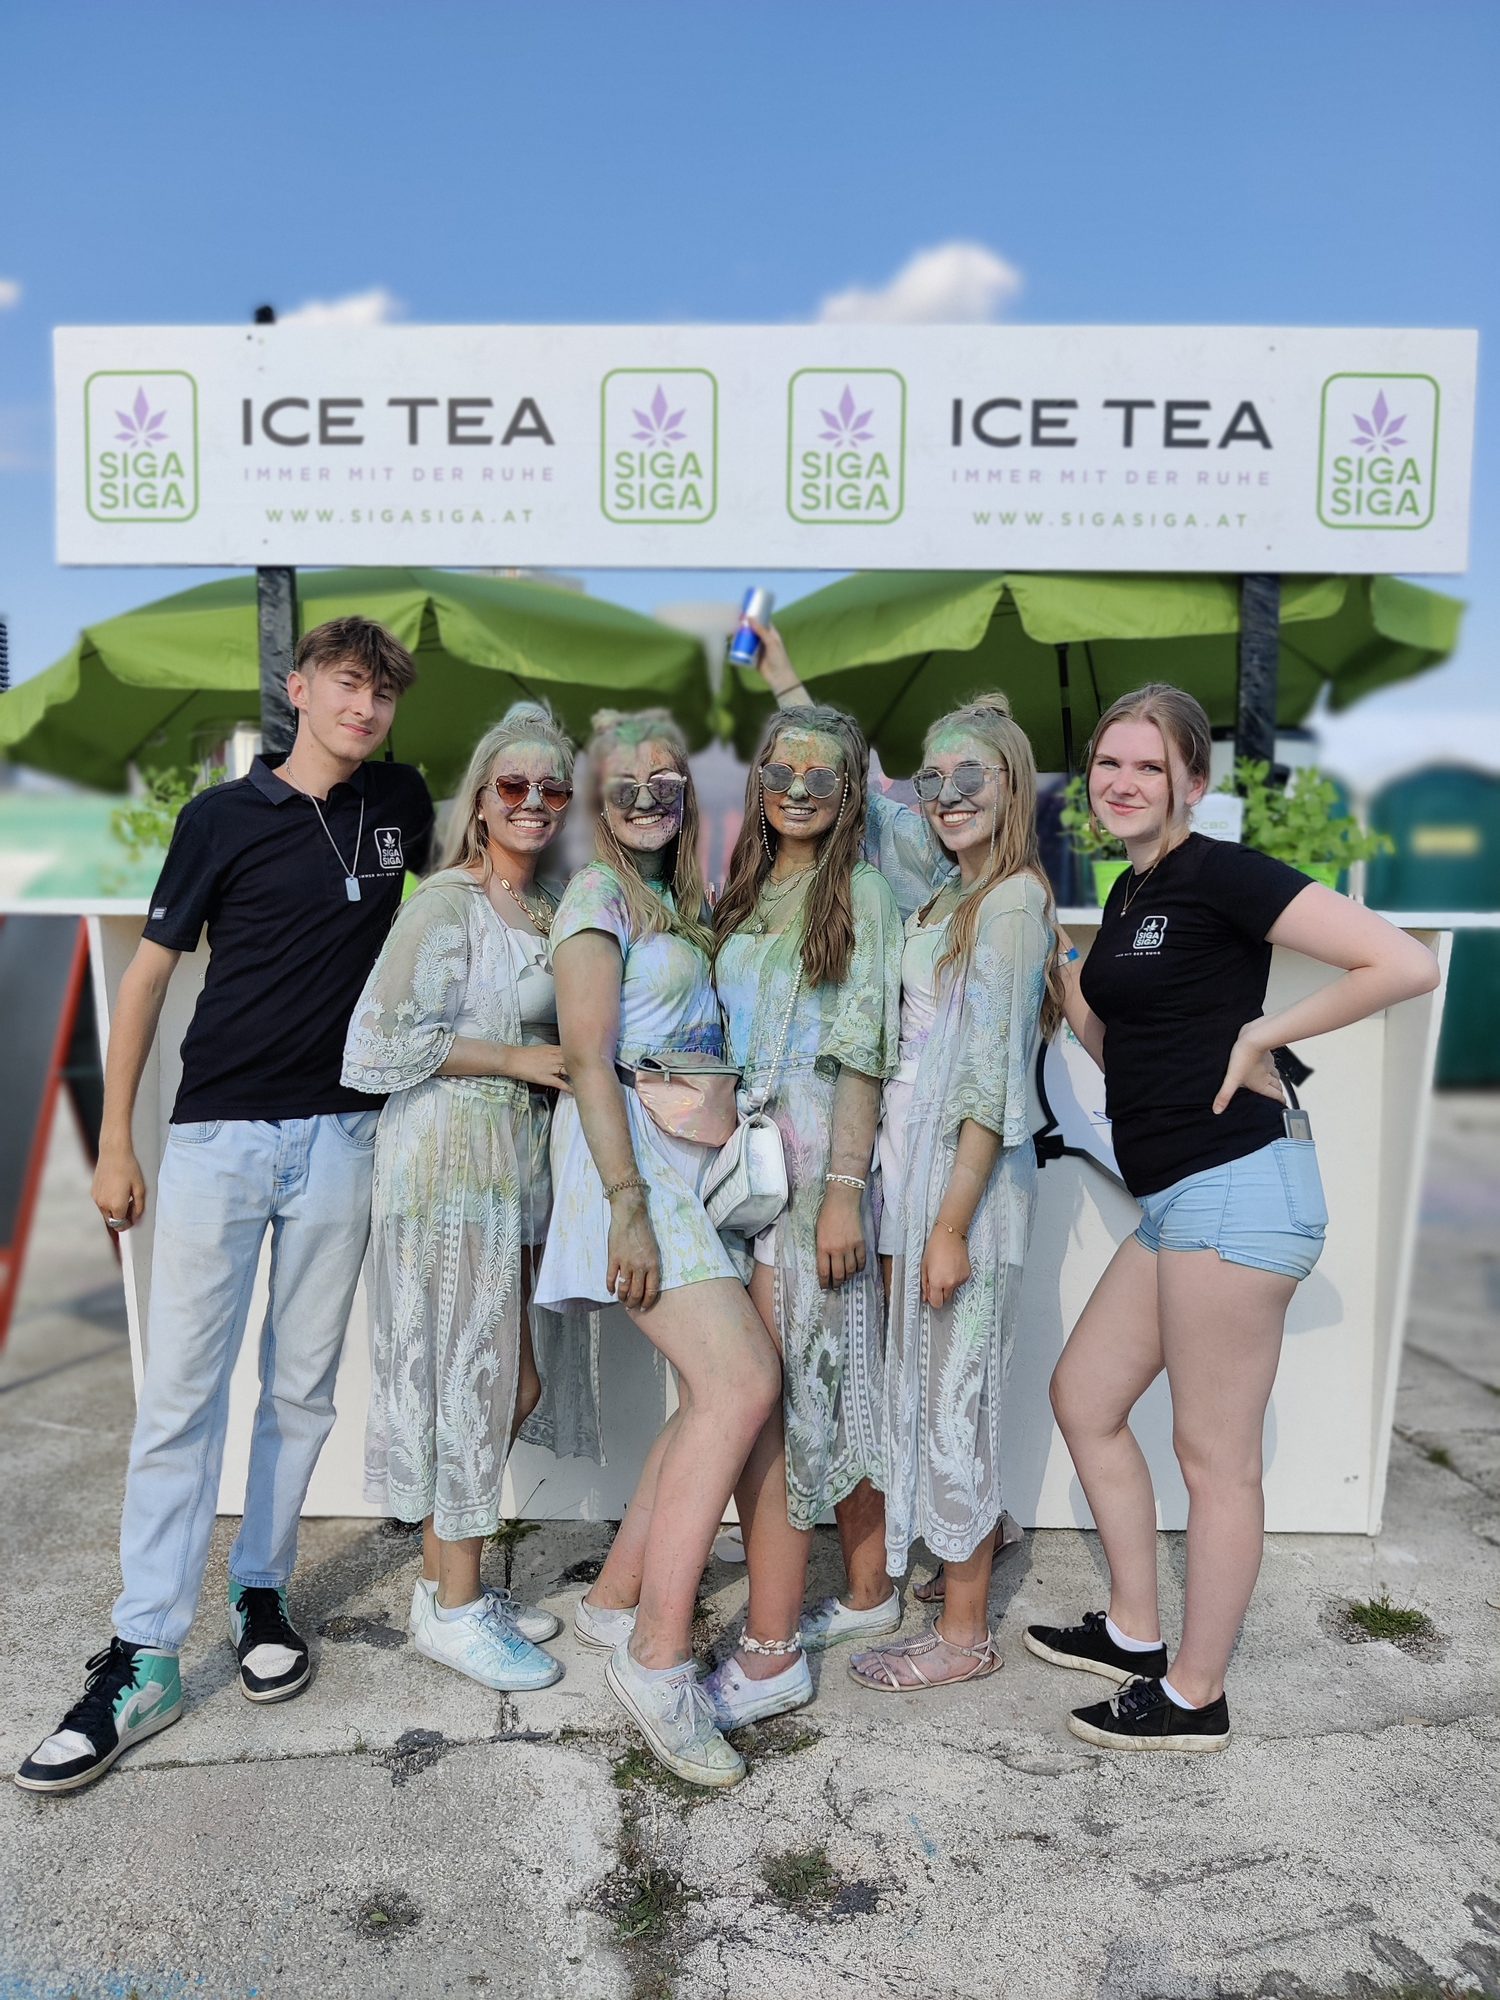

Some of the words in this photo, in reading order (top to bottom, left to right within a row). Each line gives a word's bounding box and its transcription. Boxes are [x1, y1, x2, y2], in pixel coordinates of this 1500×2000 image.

[243, 397, 364, 446] ICE
[388, 398, 556, 446] TEA
[952, 397, 1079, 448] ICE
[1102, 400, 1274, 450] TEA
[99, 451, 185, 479] SIGA
[244, 466, 331, 482] IMMER
[348, 466, 394, 482] MIT
[412, 466, 465, 482] DER
[481, 466, 556, 482] RUHE
[614, 451, 703, 480] SIGA
[801, 451, 890, 480] SIGA
[952, 468, 1042, 484] IMMER
[1060, 469, 1107, 485] MIT
[1125, 470, 1179, 486] DER
[1197, 471, 1271, 487] RUHE
[1332, 456, 1422, 485] SIGA
[99, 482, 185, 510] SIGA
[614, 482, 703, 511] SIGA
[801, 482, 890, 511] SIGA
[1330, 487, 1420, 516] SIGA
[265, 508, 534, 525] WWW.SIGASIGA.AT
[972, 511, 1249, 529] WWW.SIGASIGA.AT
[383, 857, 401, 865] SIGA
[1136, 938, 1157, 946] SIGA
[1138, 931, 1159, 940] SIGA
